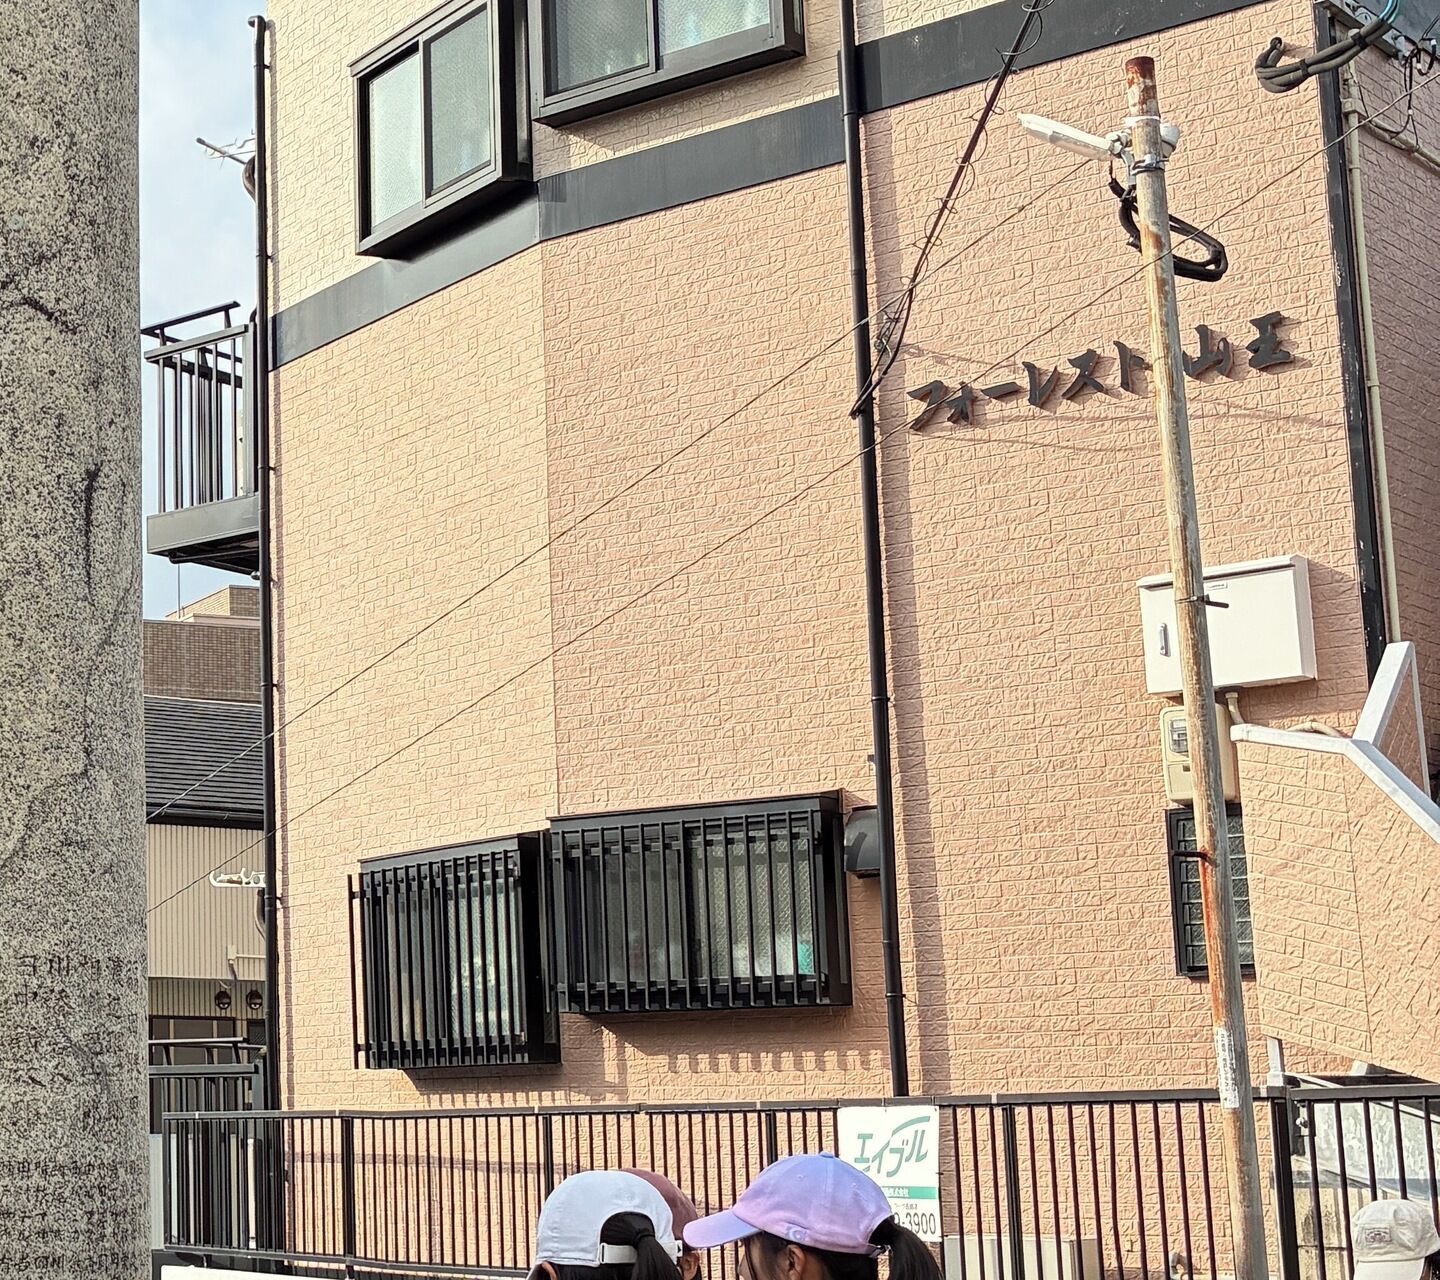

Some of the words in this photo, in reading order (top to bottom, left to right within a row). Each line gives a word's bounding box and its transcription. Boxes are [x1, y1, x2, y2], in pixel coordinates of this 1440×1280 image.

[906, 311, 1294, 431] フォーレスト山王
[853, 1115, 931, 1179] エイブル
